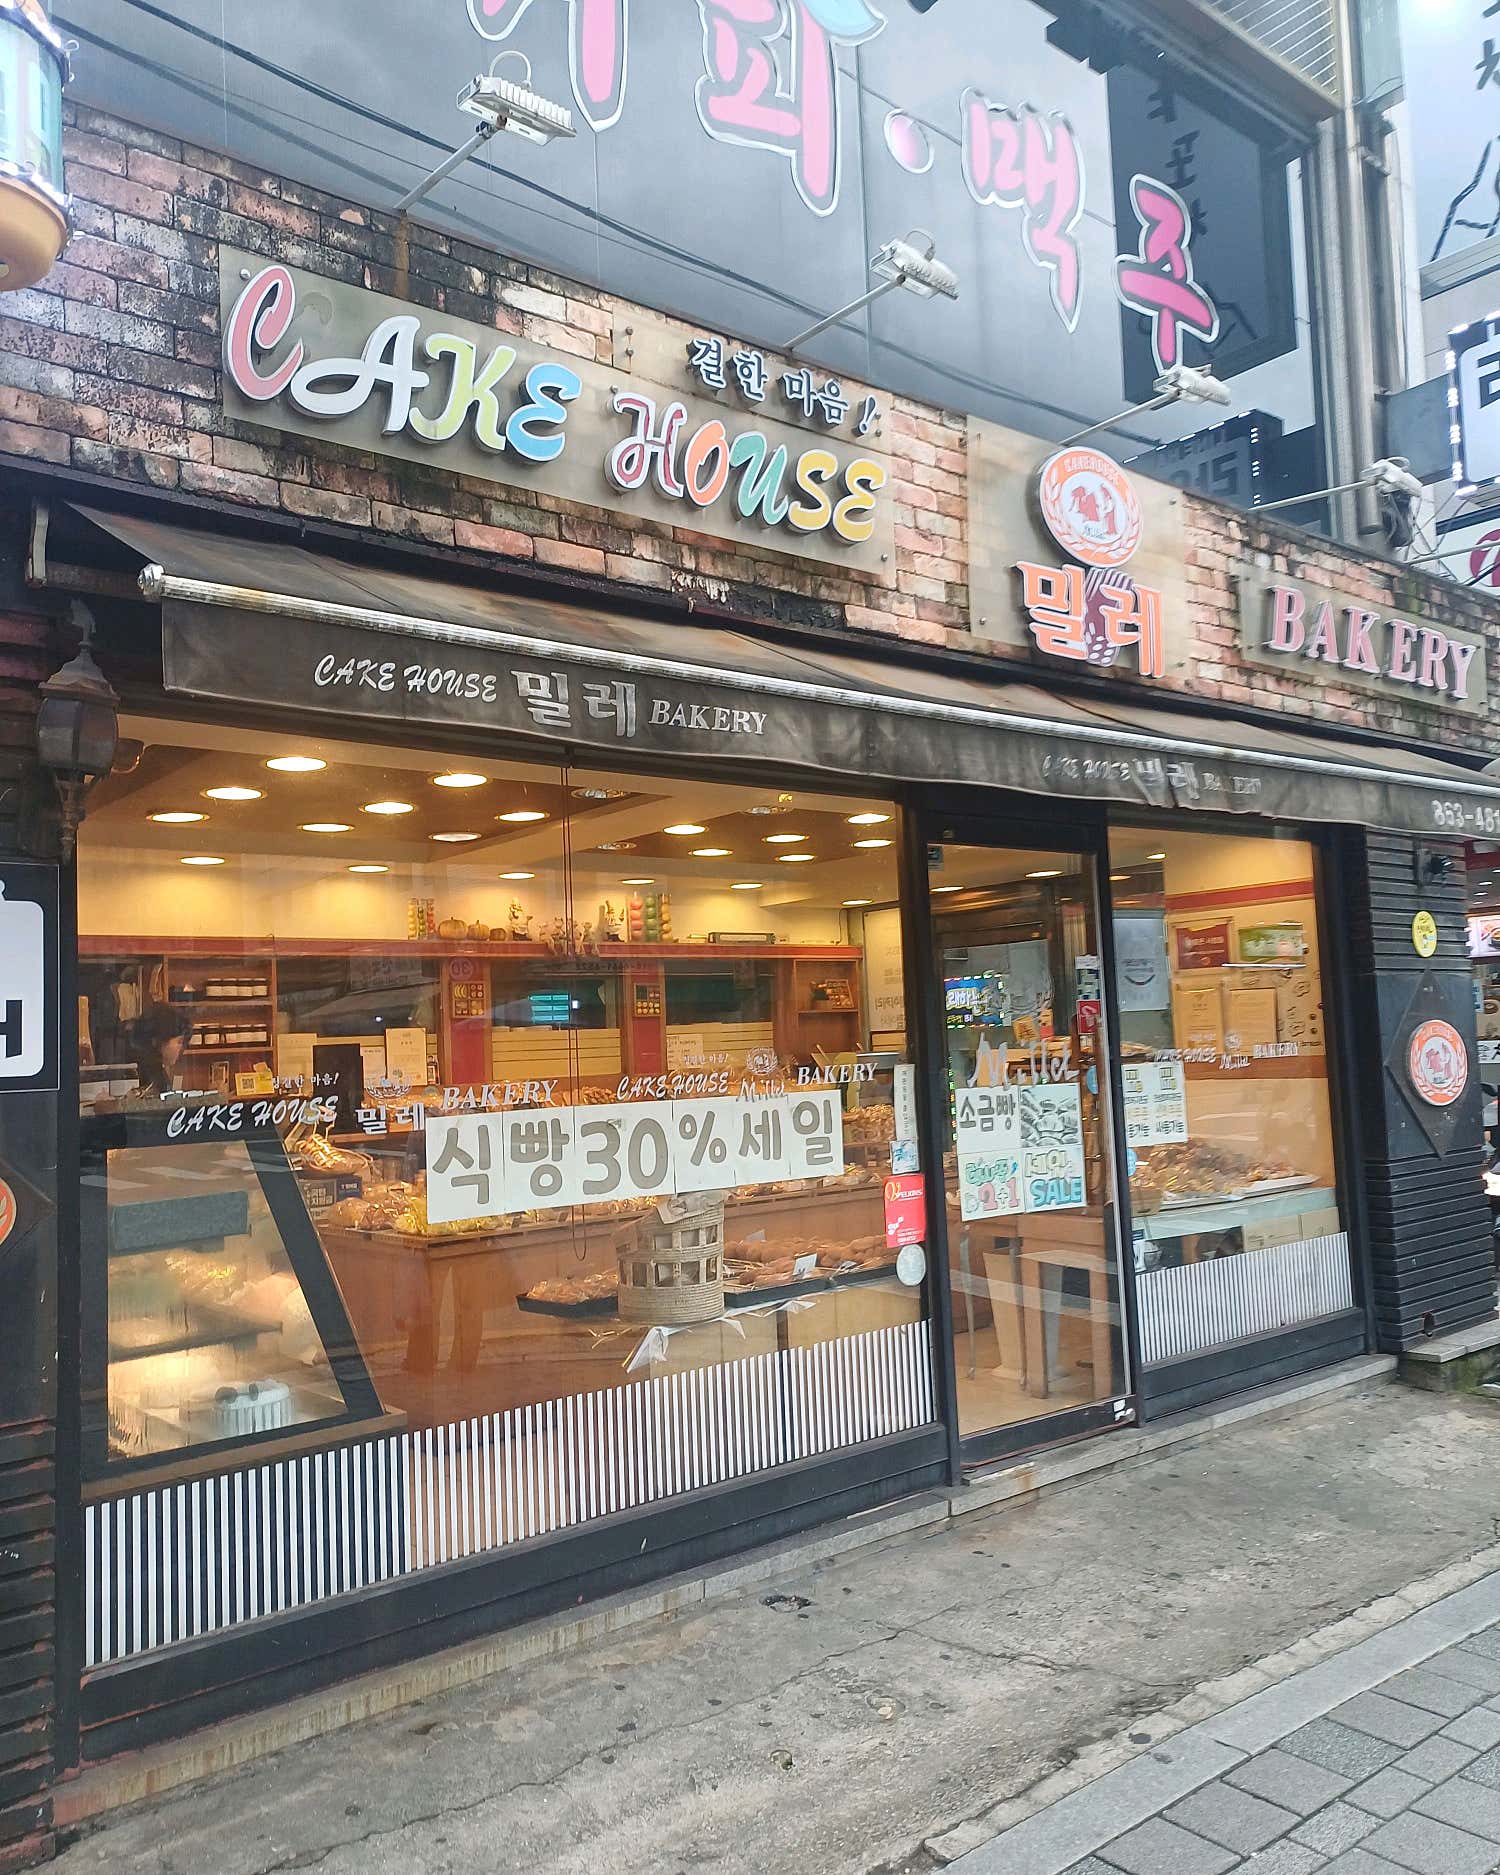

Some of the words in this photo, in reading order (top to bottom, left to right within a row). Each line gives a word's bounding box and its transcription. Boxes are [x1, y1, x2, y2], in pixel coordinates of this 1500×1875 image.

[222, 264, 582, 464] CAKE
[609, 391, 887, 542] HOUSE
[1016, 560, 1164, 678] 밀레
[1265, 585, 1478, 699] BAKERY
[314, 655, 395, 691] CAKE
[403, 664, 497, 703] HOUSE
[511, 669, 637, 737] 밀레
[649, 699, 768, 735] BAKERY
[167, 1101, 243, 1137] CAKE
[250, 1096, 338, 1128] HOUSE
[355, 1102, 426, 1135] 밀레
[441, 1079, 559, 1111] BAKERY
[616, 1074, 667, 1100] CAKE
[670, 1072, 729, 1097] HOUSE
[797, 1062, 878, 1086] BAKERY
[960, 1093, 1016, 1132] 소금빵
[1030, 1177, 1083, 1207] SALE
